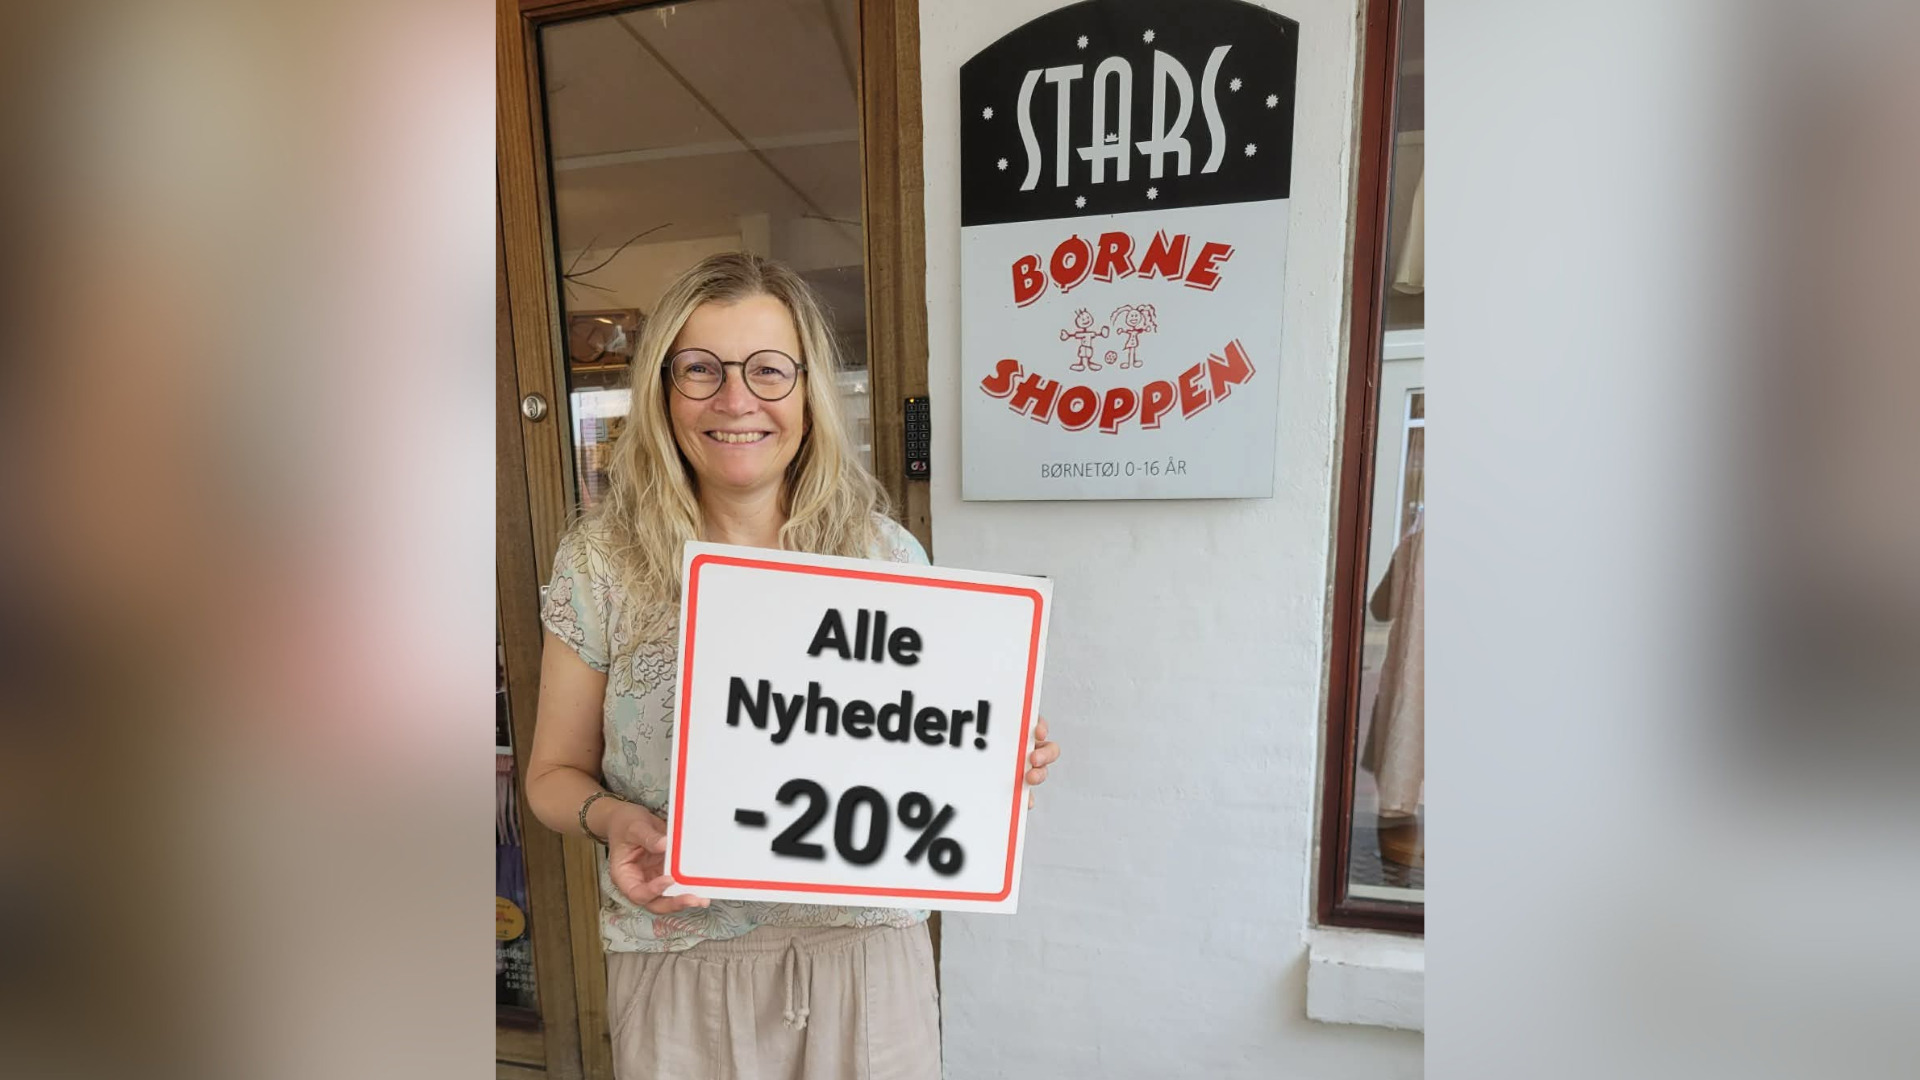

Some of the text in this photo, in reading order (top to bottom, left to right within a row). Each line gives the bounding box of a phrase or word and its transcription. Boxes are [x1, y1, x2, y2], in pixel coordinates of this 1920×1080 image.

[1017, 45, 1232, 191] STARS
[1012, 229, 1235, 308] BØRNE
[980, 338, 1256, 435] SHOPPEN
[1041, 456, 1187, 478] BØRNETØJ 0-16 ÅR
[807, 608, 922, 666] Alle
[726, 676, 990, 750] Nyheder!
[734, 777, 964, 877] -20%
